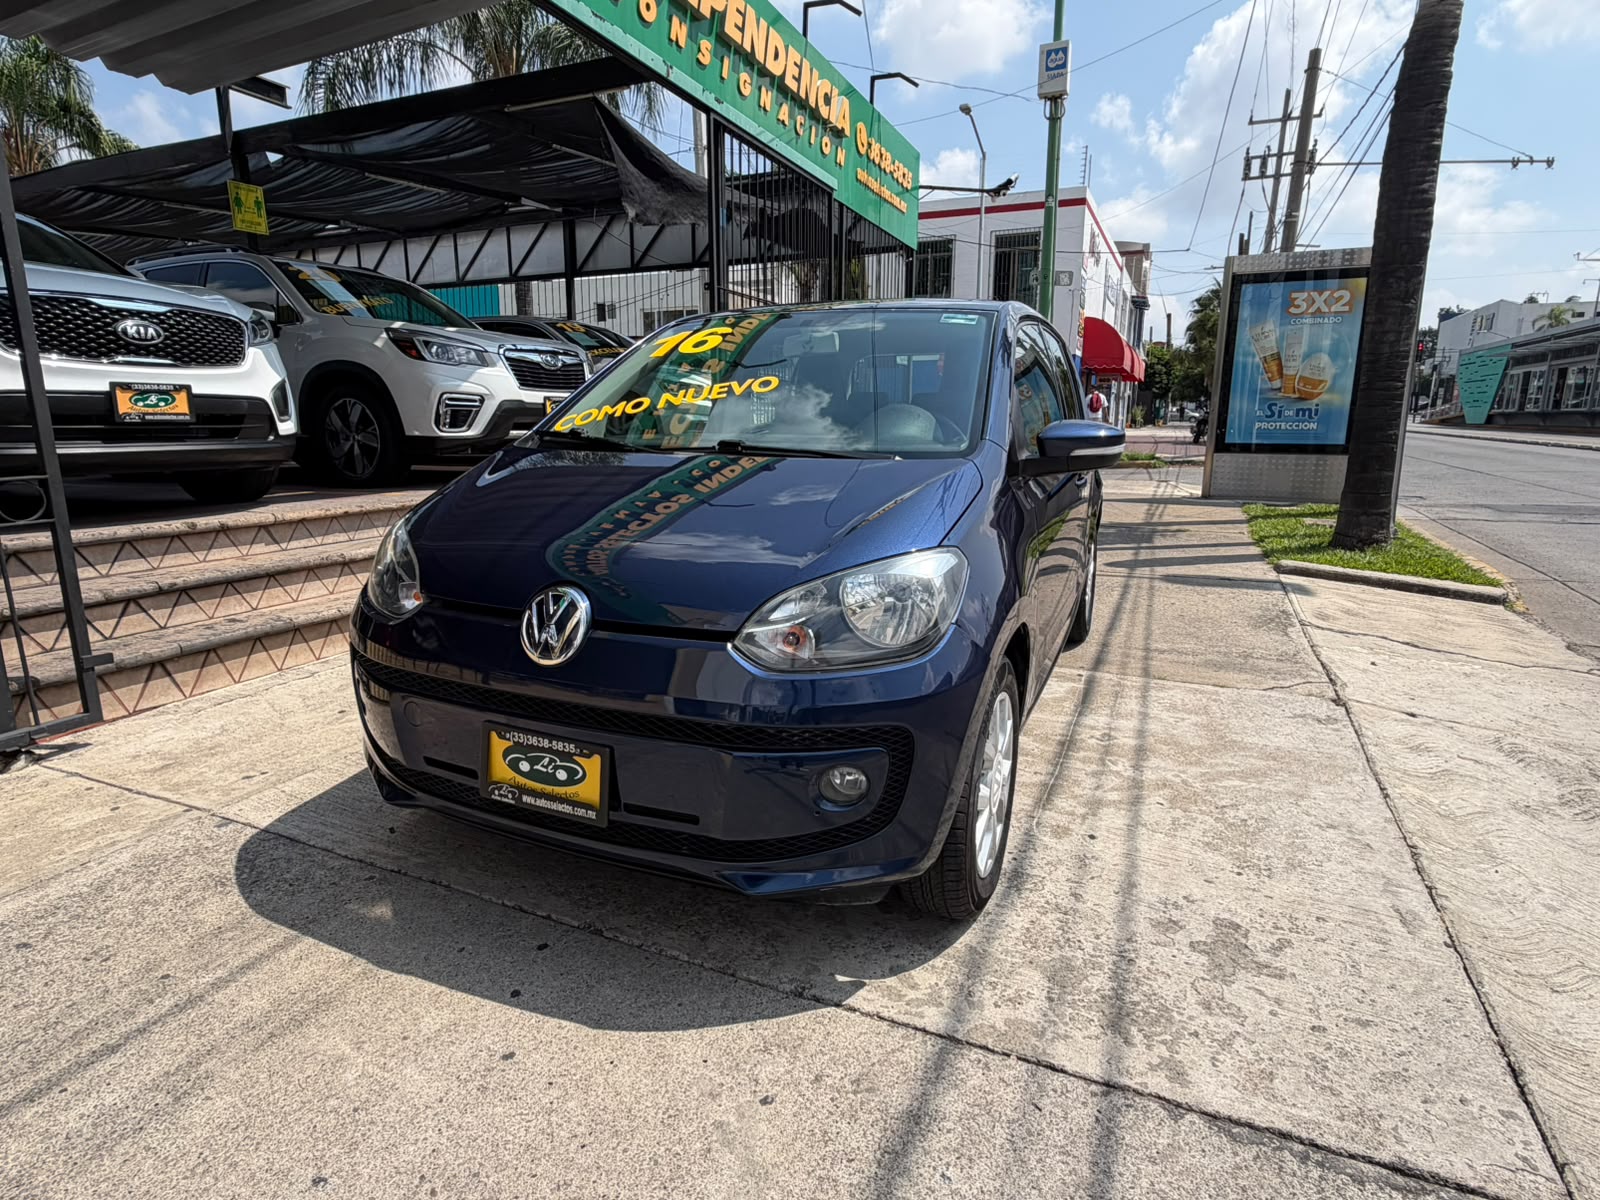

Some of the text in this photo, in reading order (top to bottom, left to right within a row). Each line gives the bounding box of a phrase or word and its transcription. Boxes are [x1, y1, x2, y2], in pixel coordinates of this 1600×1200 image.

[1288, 289, 1351, 314] 3X2
[1290, 316, 1342, 325] COMBINADO
[126, 325, 158, 340] KIA
[650, 327, 733, 359] 16
[554, 376, 780, 431] COMO NUEVO
[1265, 402, 1283, 418] Sí
[1295, 403, 1320, 420] mi
[510, 731, 576, 754] (33)3638-5835
[533, 757, 555, 774] Li
[508, 776, 537, 795] Autos
[522, 794, 597, 820] www.autosselectos.com.mx
